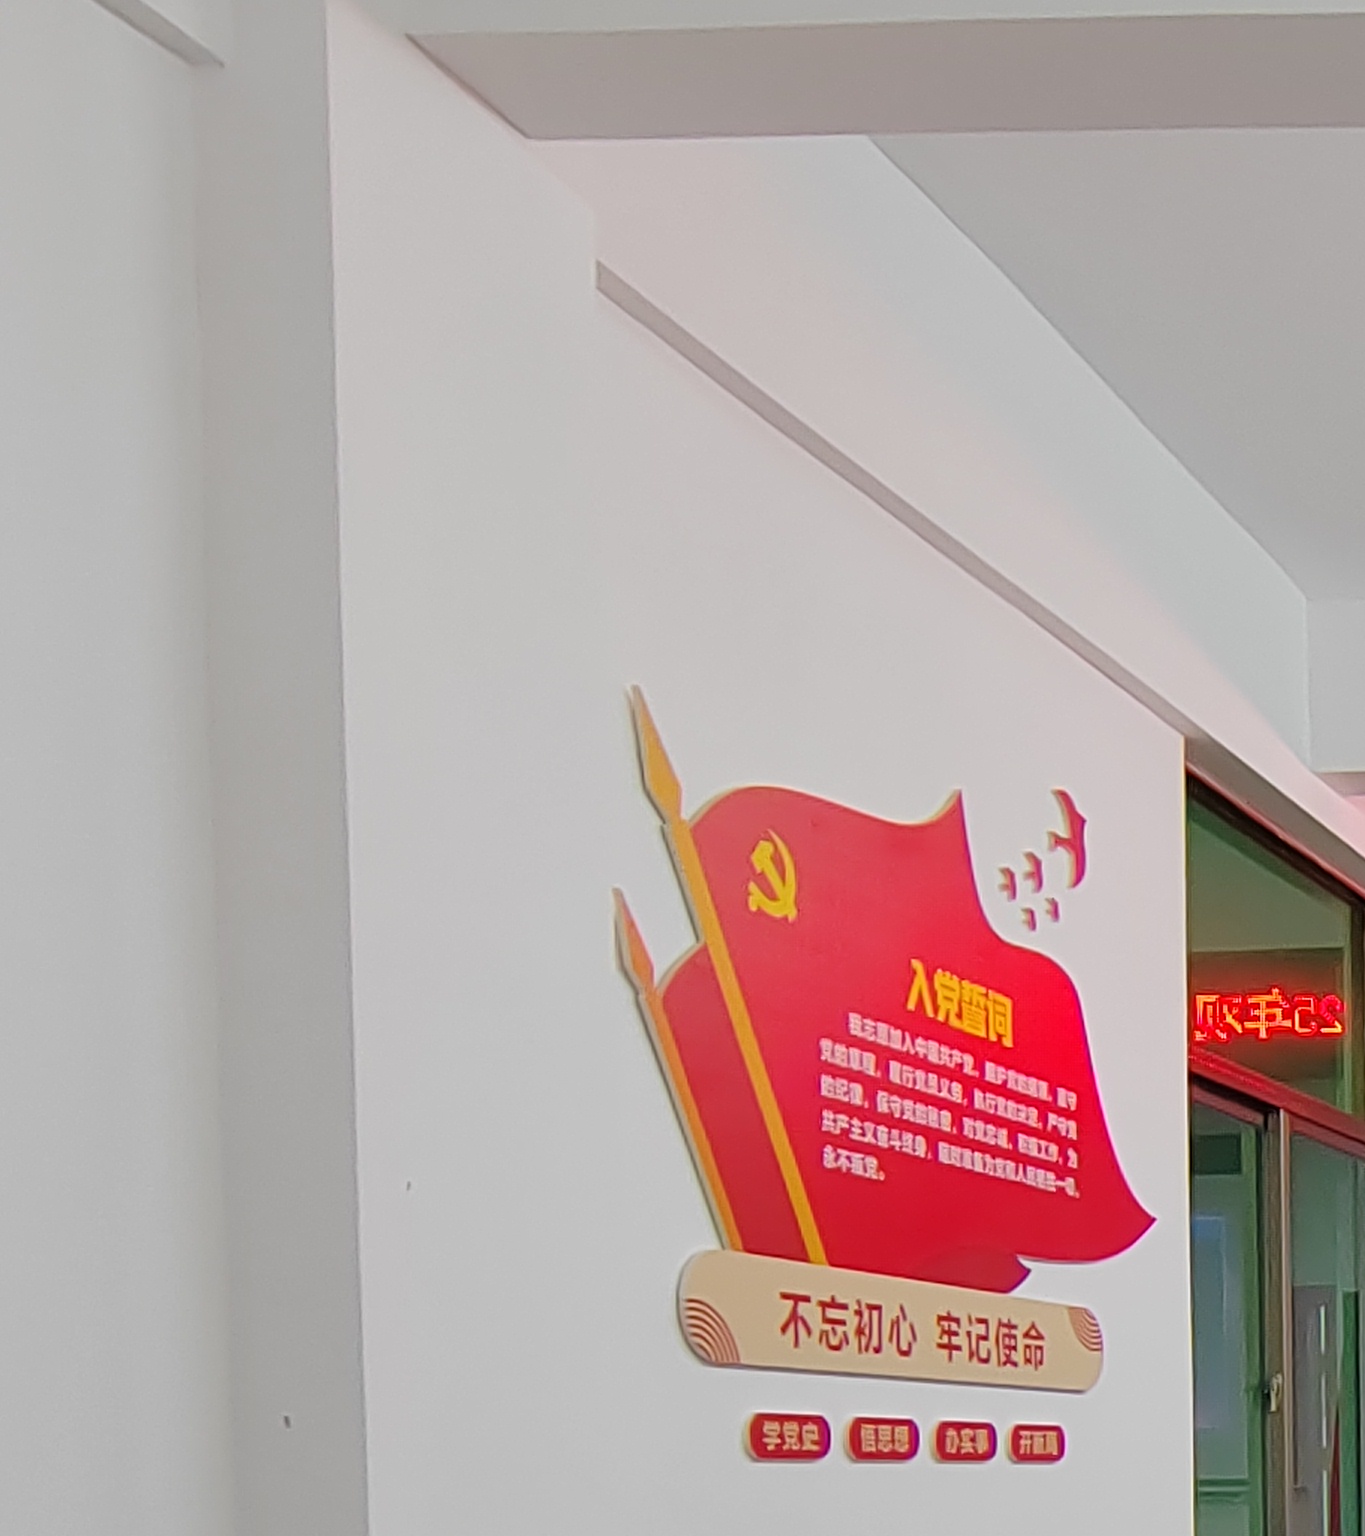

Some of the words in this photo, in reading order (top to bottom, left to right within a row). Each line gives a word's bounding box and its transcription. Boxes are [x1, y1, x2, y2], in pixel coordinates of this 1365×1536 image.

[906, 958, 1014, 1049] 入党誓词
[779, 1291, 917, 1358] 不忘初心
[935, 1311, 1046, 1371] 牢记使命
[762, 1420, 820, 1452] 学党史
